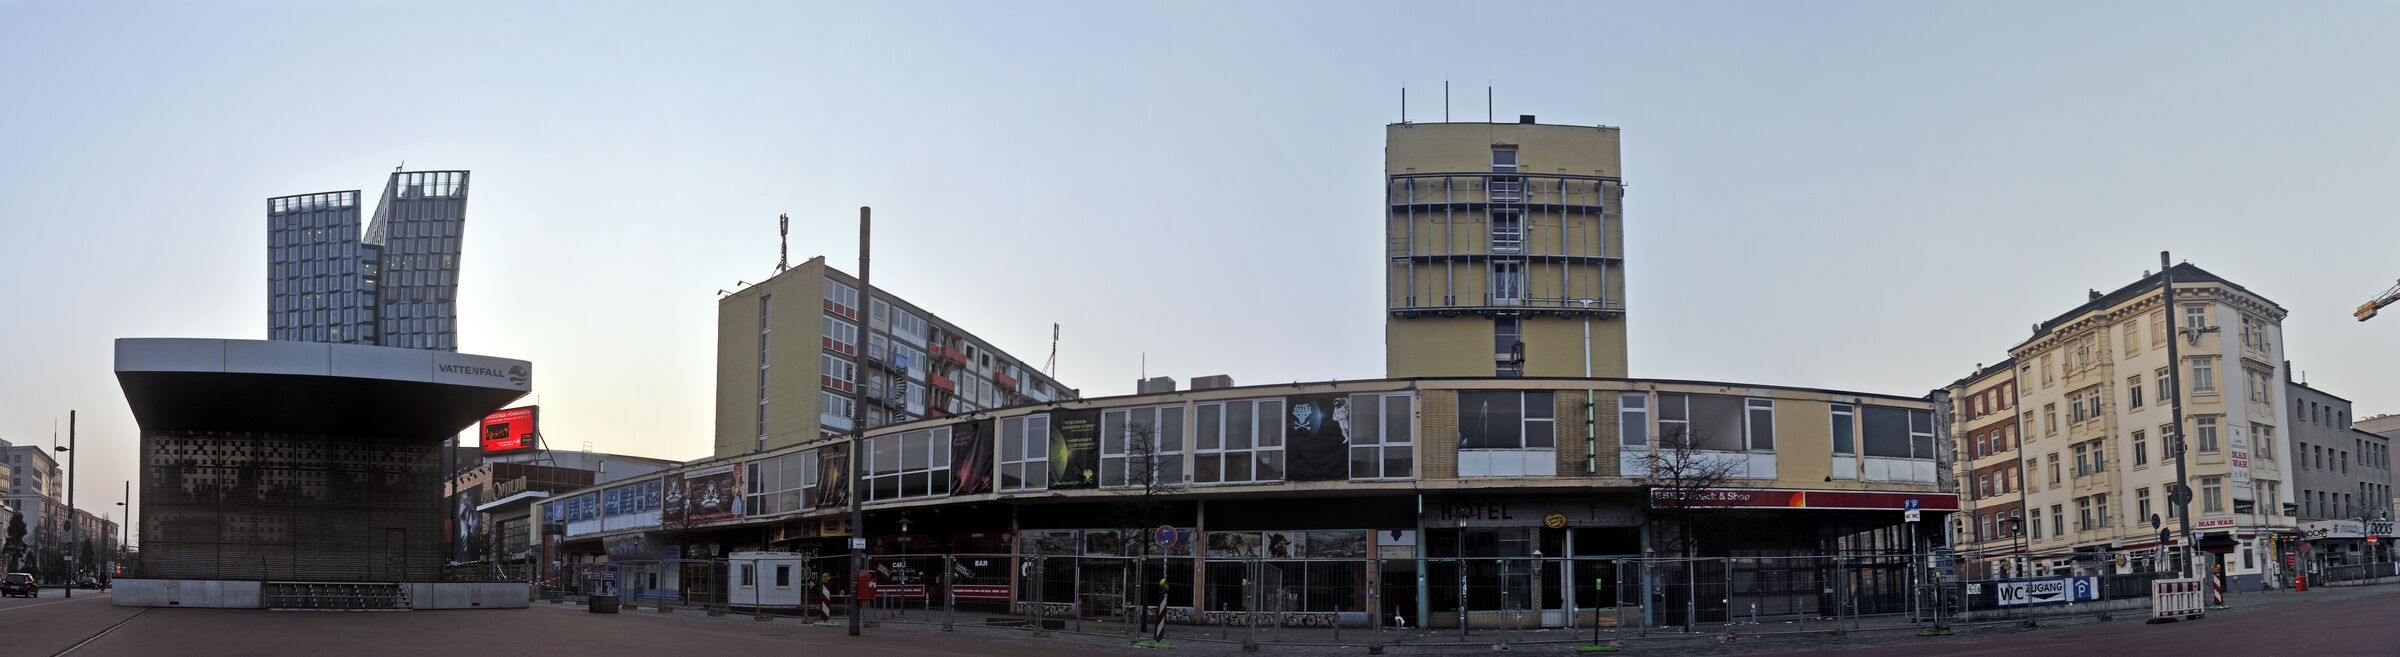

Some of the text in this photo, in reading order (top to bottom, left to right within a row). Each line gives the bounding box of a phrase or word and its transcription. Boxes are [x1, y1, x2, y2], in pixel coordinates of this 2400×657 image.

[439, 363, 505, 378] VATTENFALL
[2231, 450, 2248, 460] MAN
[1689, 492, 1717, 500] ack
[1719, 492, 1726, 500] &
[1727, 492, 1750, 501] Shop
[1441, 503, 1513, 521] HOTEL
[2198, 520, 2216, 528] MAN
[2371, 522, 2393, 535] DOCKS
[2000, 582, 2063, 601] WC ZUGANG
[2078, 584, 2086, 598] P
